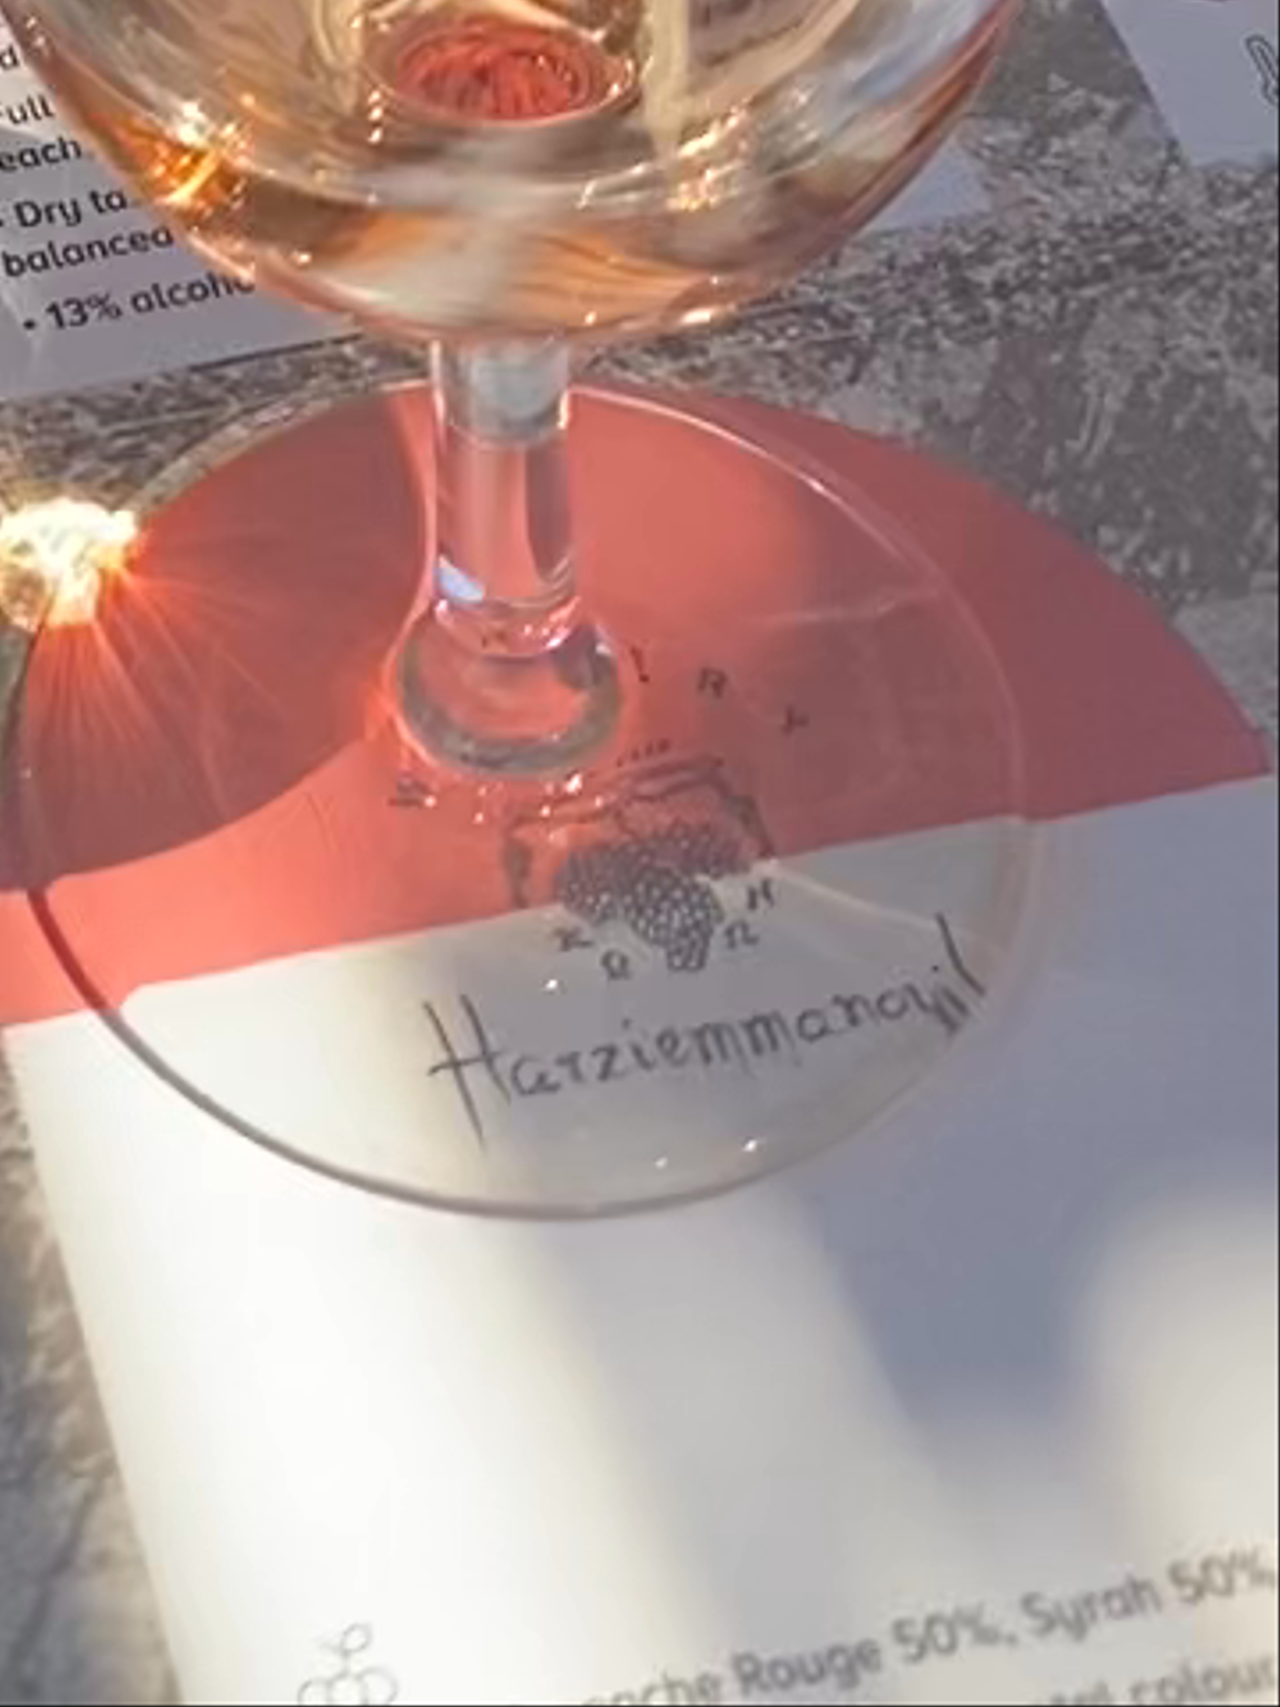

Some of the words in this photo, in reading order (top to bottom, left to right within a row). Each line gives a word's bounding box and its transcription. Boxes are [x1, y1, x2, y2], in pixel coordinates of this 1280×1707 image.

[14, 194, 82, 229] Dry
[88, 187, 130, 215] ta
[46, 292, 123, 330] 13%
[732, 1637, 883, 1696] Rouge
[1021, 1574, 1163, 1643] Syrah
